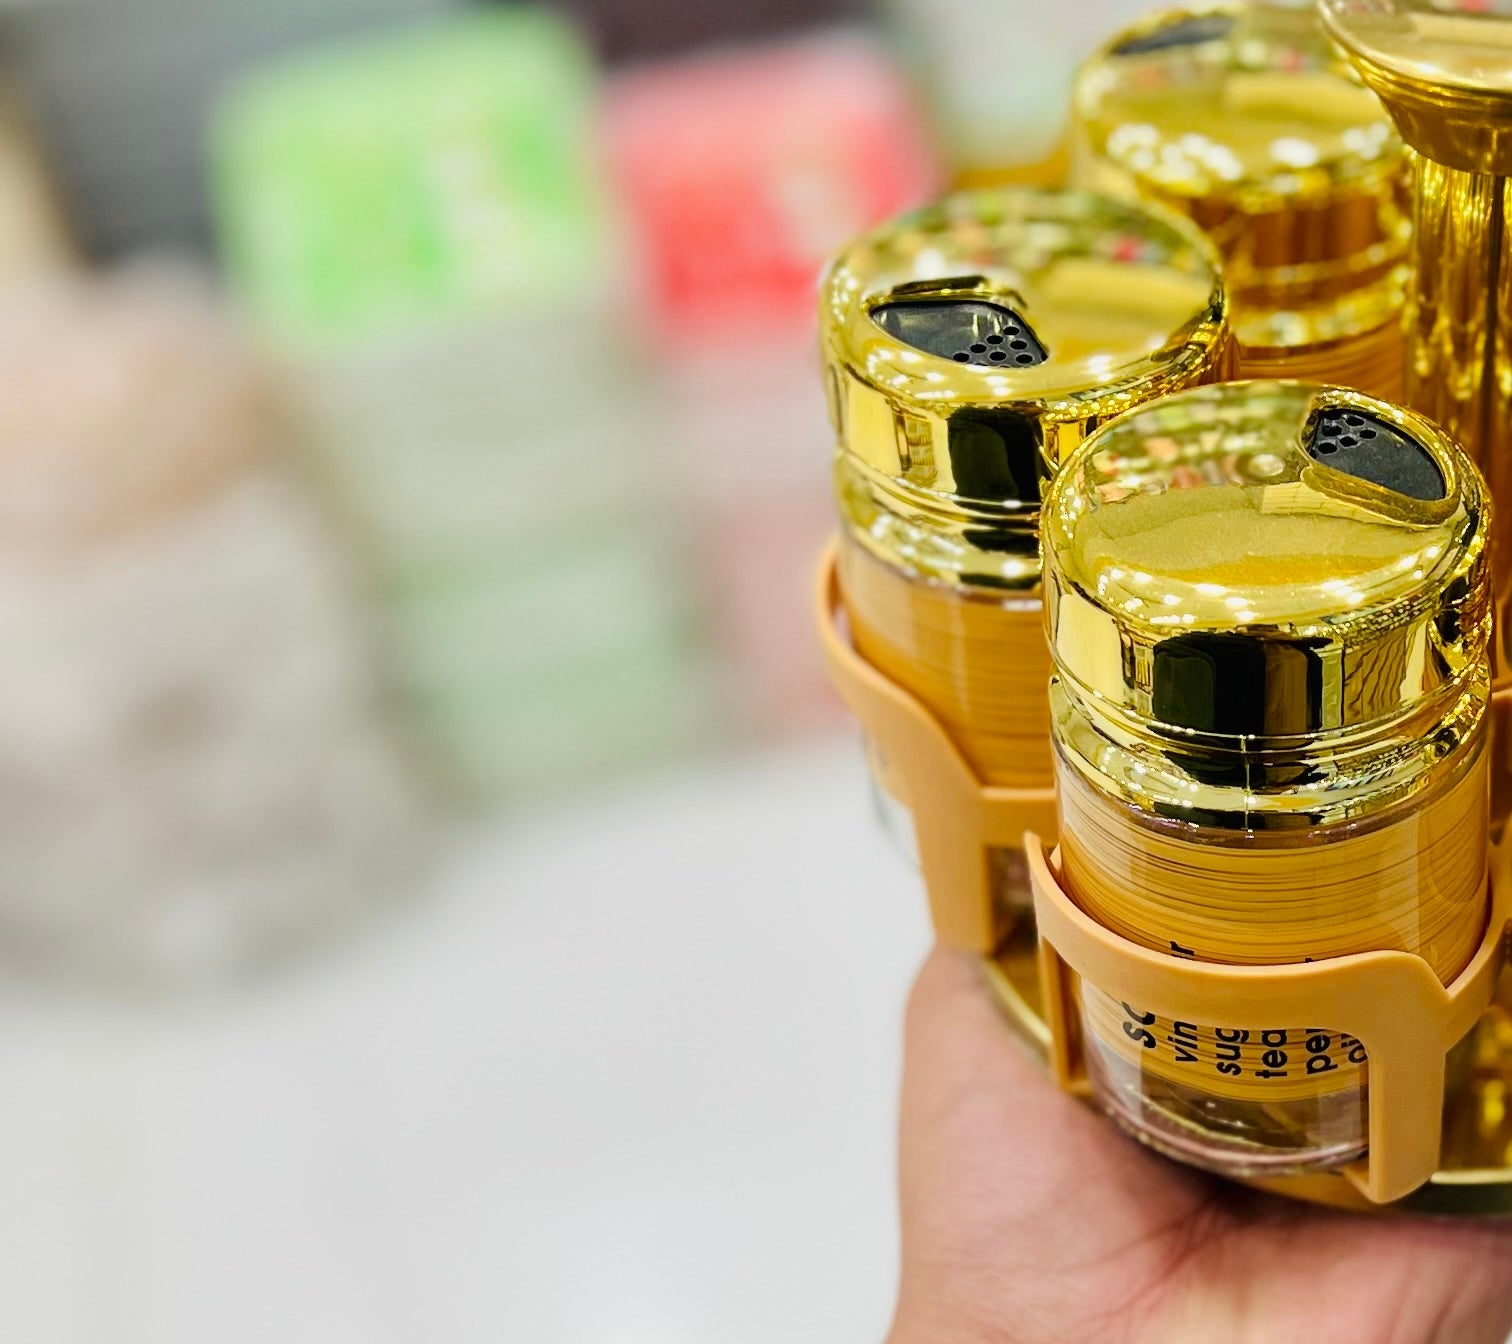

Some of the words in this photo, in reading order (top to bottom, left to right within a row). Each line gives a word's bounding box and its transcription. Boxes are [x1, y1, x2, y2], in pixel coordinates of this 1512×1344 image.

[1215, 1027, 1250, 1076] sug
[1255, 1029, 1287, 1079] tea
[1305, 1028, 1338, 1075] pe
